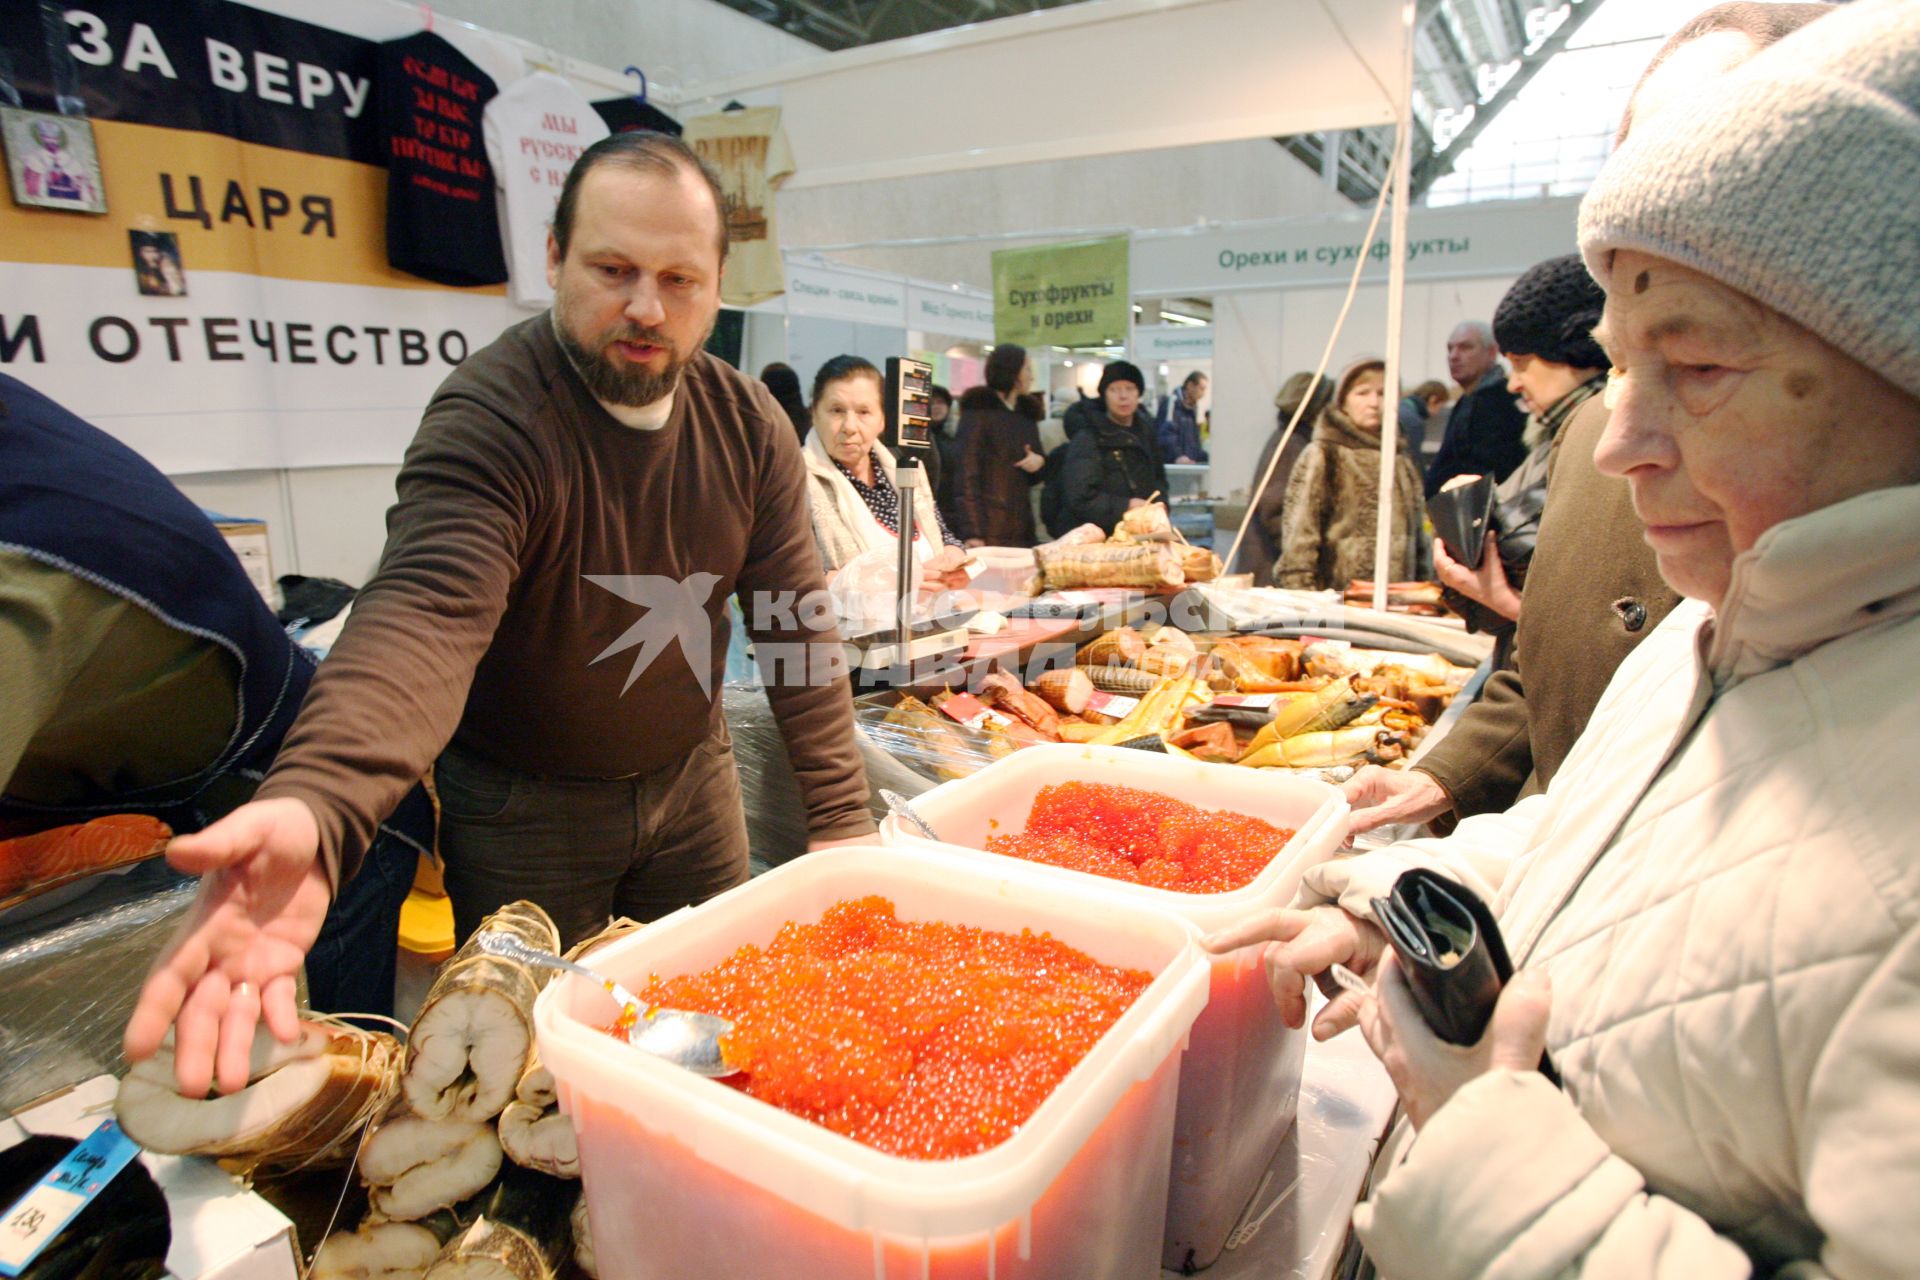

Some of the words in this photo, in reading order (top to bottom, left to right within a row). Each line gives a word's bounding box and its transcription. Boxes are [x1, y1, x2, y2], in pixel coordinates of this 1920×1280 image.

[64, 10, 177, 79] ЗА
[204, 36, 371, 119] ВЕРУ
[158, 172, 336, 239] ЦАРЯ
[1217, 249, 1288, 271] Орехи
[1295, 246, 1308, 263] и
[1315, 236, 1470, 265] сухофукты
[88, 315, 469, 366] ОТЕЧЕСТВО
[1044, 309, 1094, 330] орехи
